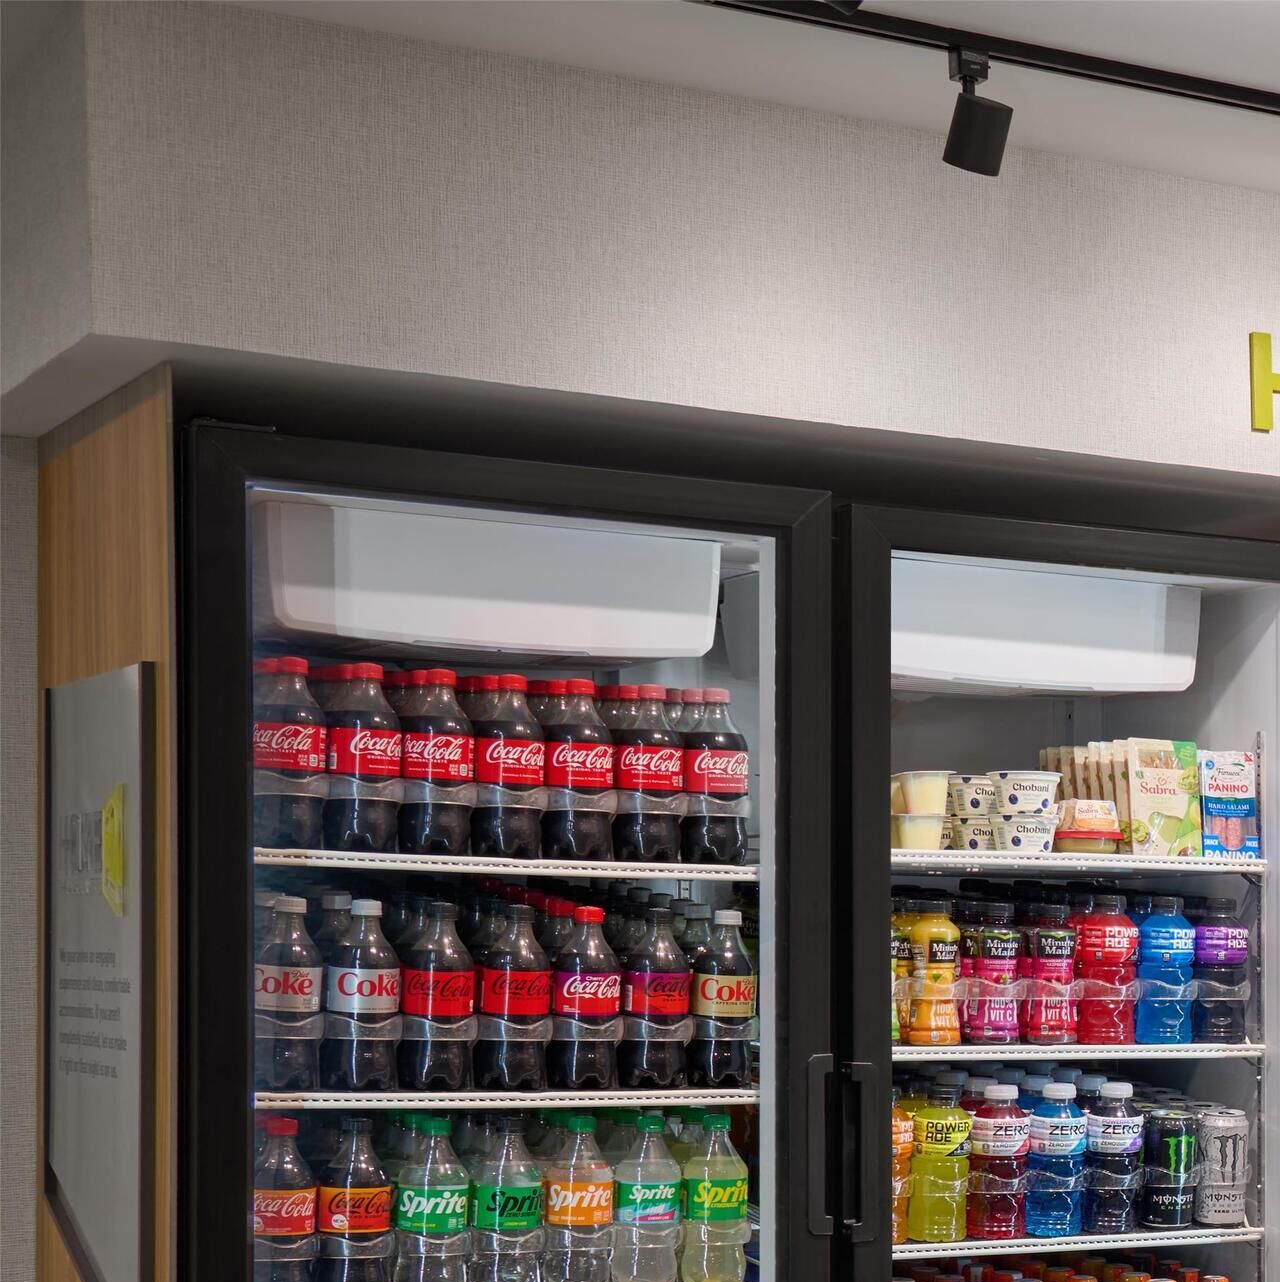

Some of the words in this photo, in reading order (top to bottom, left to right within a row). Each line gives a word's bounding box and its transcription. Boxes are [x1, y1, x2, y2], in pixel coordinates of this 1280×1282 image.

[621, 746, 681, 771] Coca-Cola
[1012, 782, 1049, 793] Chobani
[1139, 781, 1176, 796] Sabra
[1207, 783, 1249, 794] PANINO
[1207, 803, 1225, 811] HARD
[1205, 849, 1255, 860] PANINO
[986, 939, 1018, 949] Minute
[1040, 938, 1076, 948] Minute
[1105, 938, 1130, 947] ADE
[990, 947, 1015, 956] Maid
[1045, 946, 1071, 955] Maid
[926, 1121, 970, 1133] POWER
[1102, 1124, 1140, 1134] ZERO
[925, 1131, 952, 1143] ADE
[549, 1185, 611, 1208] Sprite
[629, 1185, 675, 1204] Sprite
[400, 1191, 467, 1217] Sprite
